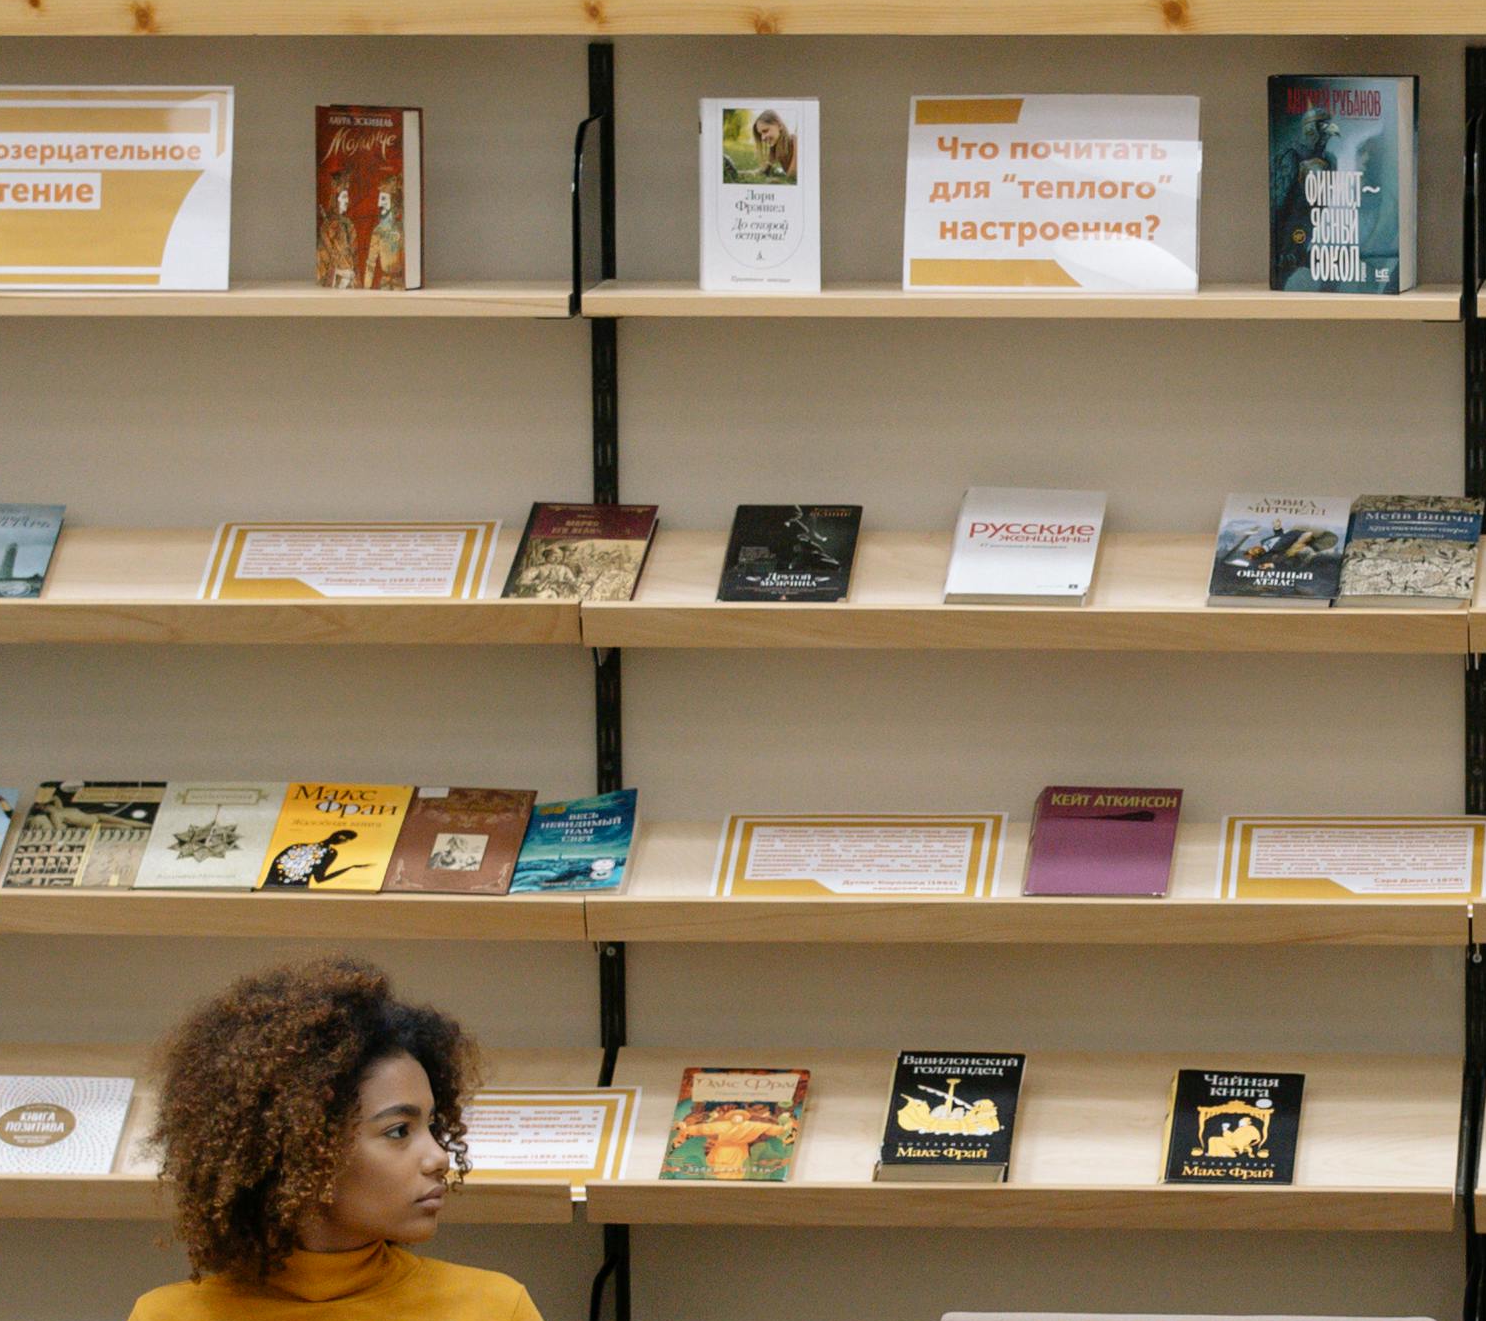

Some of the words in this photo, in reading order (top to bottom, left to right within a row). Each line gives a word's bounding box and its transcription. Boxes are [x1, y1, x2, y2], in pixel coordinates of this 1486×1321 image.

[1331, 89, 1381, 117] РУБАНОВ
[937, 137, 998, 159] Что
[1010, 140, 1167, 165] почитать
[745, 190, 774, 202] Лори
[930, 179, 990, 202] для
[735, 202, 784, 215] Фрэнкел
[939, 215, 1160, 245] настроения?
[1310, 203, 1359, 245] ЯСНЫЙ
[1310, 243, 1360, 282] СОКОЛ
[968, 523, 1096, 542] русские
[998, 532, 1092, 544] женщины
[294, 785, 378, 801] Макс
[1052, 793, 1089, 806] КЕЙТ
[1094, 795, 1178, 808] АТКИНСОН
[316, 801, 399, 817] Фрай
[902, 1054, 1018, 1067] Вавилонский
[914, 1065, 1004, 1077] голландец
[1204, 1074, 1279, 1088] Чайная
[1210, 1087, 1269, 1099] книга
[19, 1112, 56, 1122] КНИГА
[4, 1121, 65, 1133] ПОЗИТИВА
